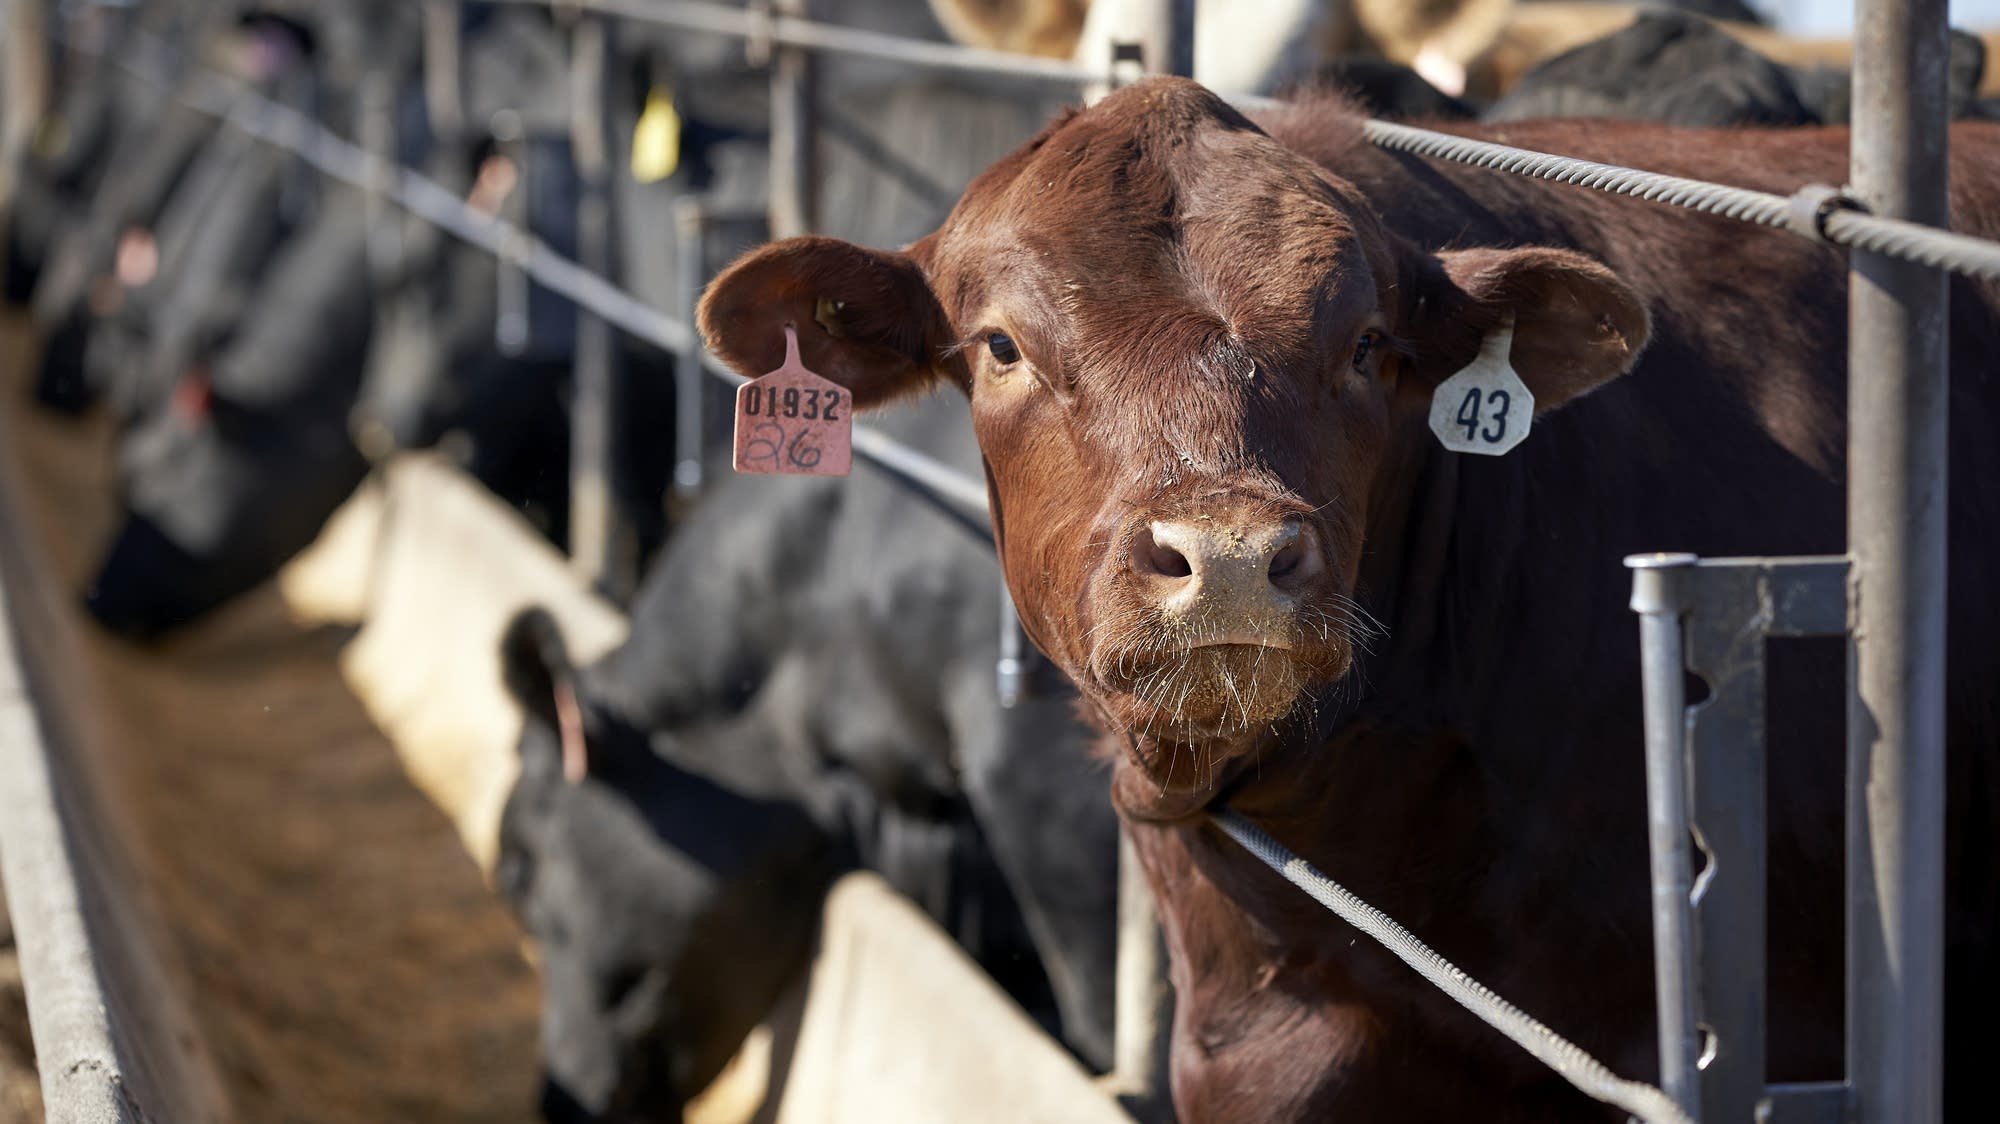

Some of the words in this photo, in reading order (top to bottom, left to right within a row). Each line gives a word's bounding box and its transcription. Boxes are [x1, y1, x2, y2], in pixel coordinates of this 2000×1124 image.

[744, 385, 840, 421] 01932
[1456, 387, 1511, 444] 43
[744, 421, 821, 470] 26
